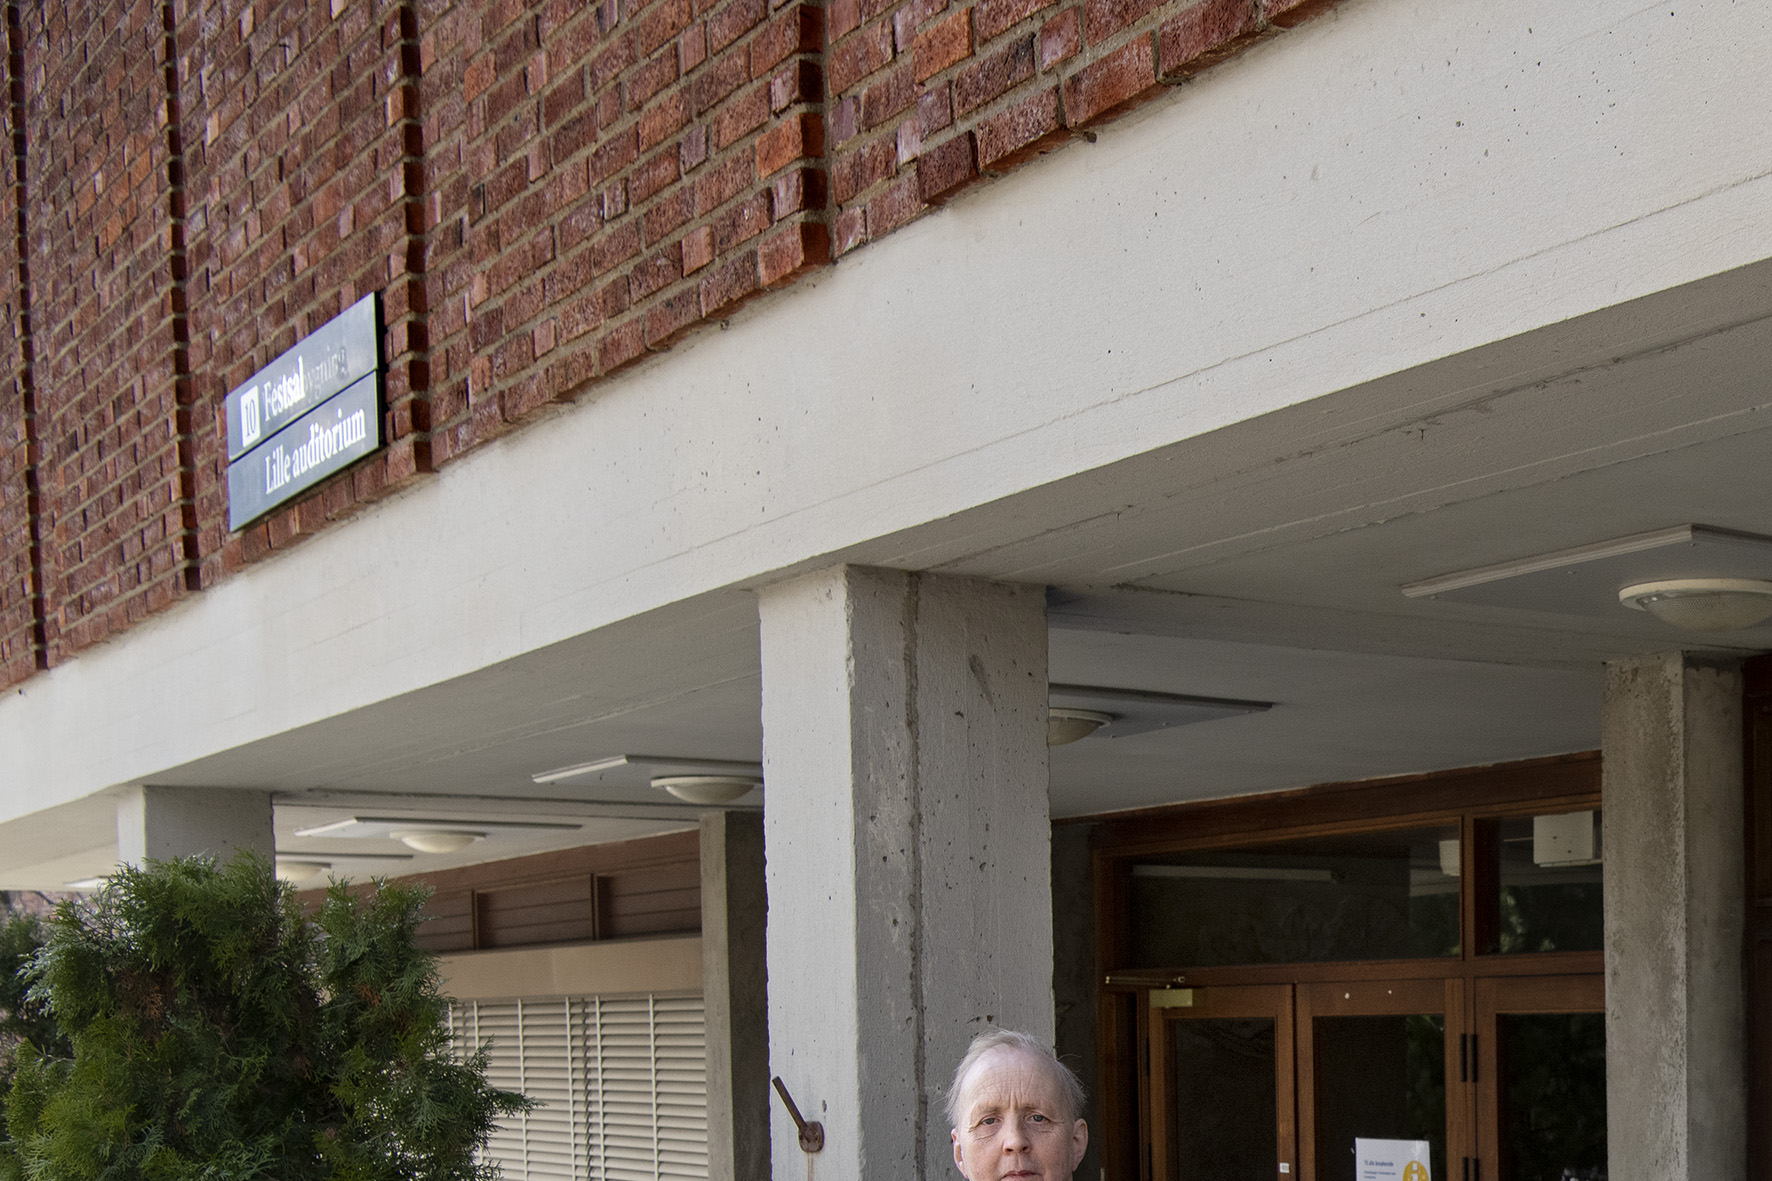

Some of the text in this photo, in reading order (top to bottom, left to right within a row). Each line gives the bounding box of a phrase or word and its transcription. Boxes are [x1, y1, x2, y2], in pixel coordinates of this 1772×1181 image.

[244, 355, 306, 438] 10 Festsal
[265, 408, 367, 495] Lille auditorium
